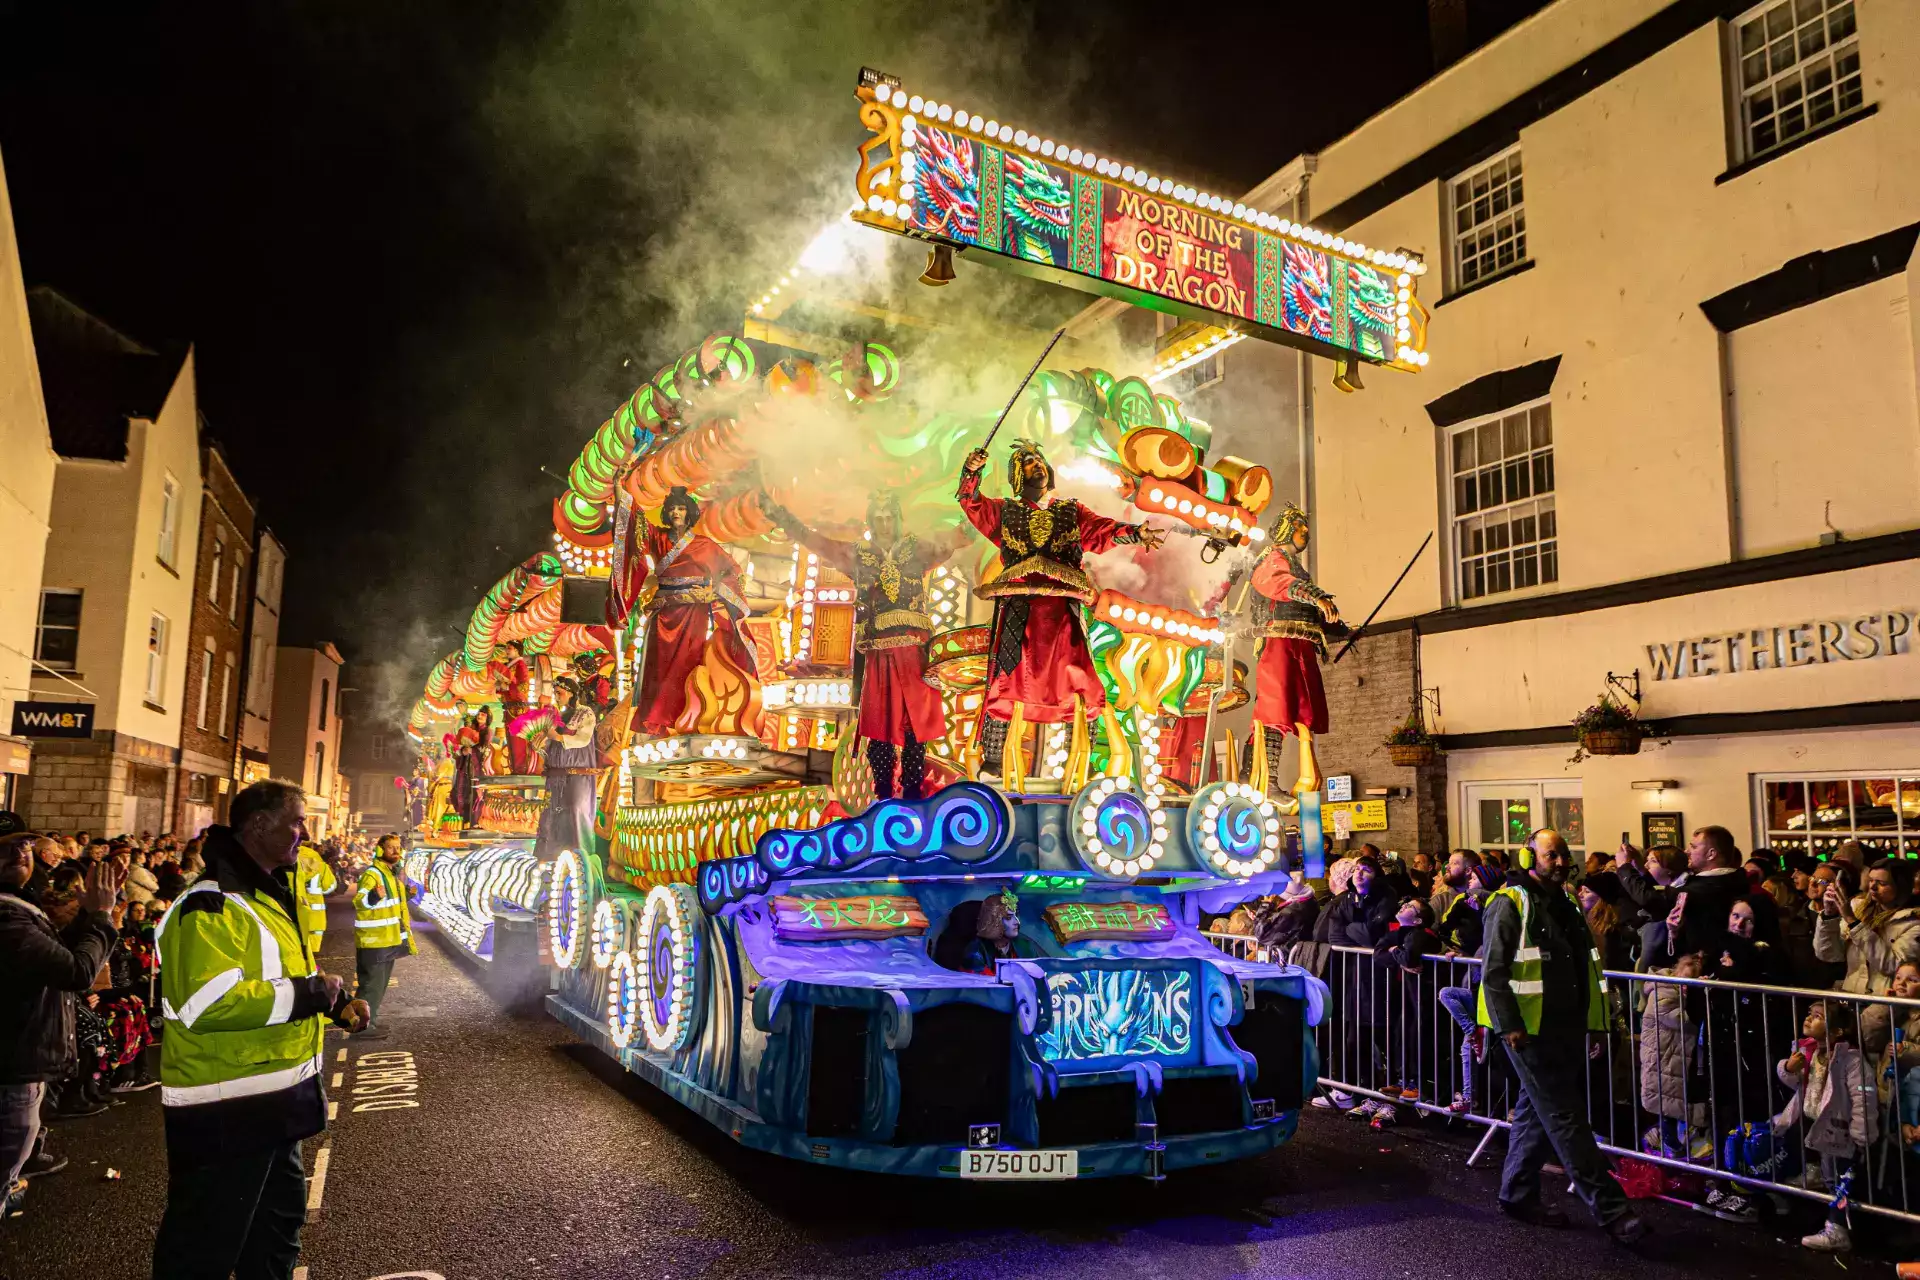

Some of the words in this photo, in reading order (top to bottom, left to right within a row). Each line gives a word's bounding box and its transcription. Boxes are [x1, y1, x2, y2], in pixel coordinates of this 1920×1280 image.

[1116, 189, 1242, 251] MORNING
[1136, 229, 1171, 260] OF
[1177, 239, 1228, 278] THE
[1111, 252, 1247, 317] DRAGON
[21, 710, 87, 729] WM&T
[1356, 821, 1385, 829] WARNING
[351, 1051, 420, 1113] DISABLED
[969, 1154, 1023, 1173] B750
[1028, 1153, 1068, 1173] OJT
